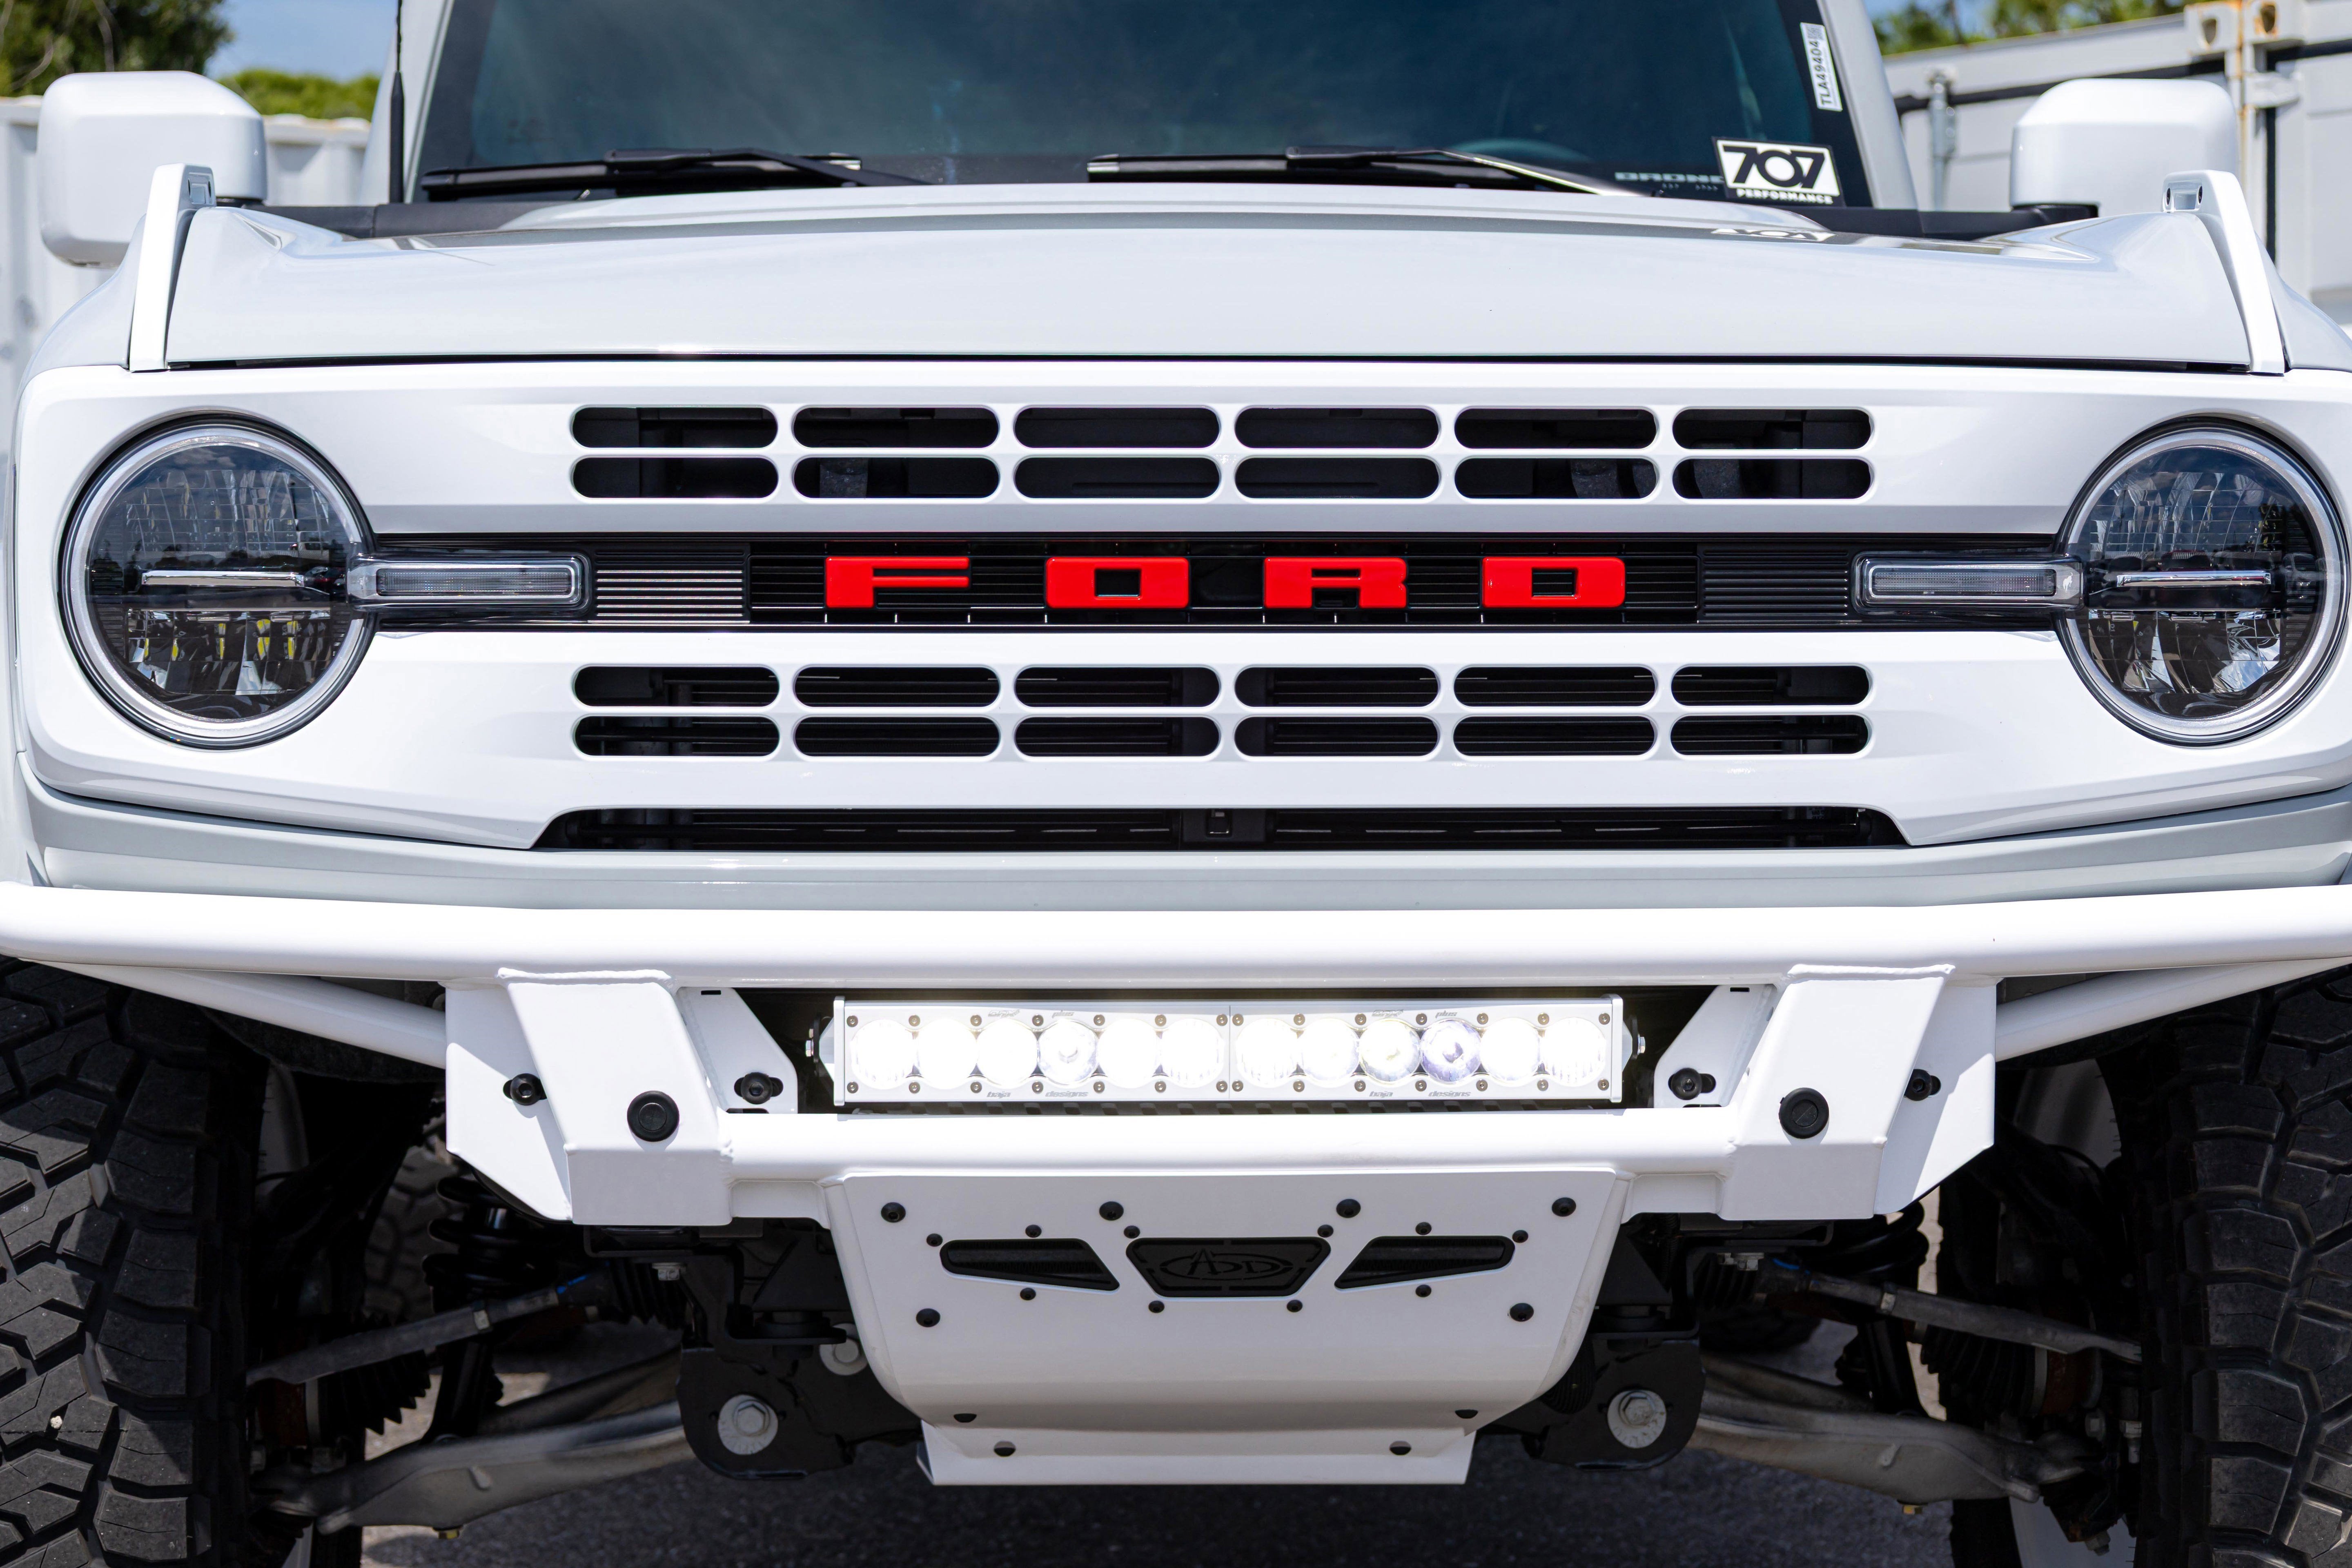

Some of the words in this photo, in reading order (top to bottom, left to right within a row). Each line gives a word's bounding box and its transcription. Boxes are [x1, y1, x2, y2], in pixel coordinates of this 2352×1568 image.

[1809, 40, 1832, 105] TLA49404
[1723, 145, 1825, 189] 707
[1736, 188, 1833, 204] PERFORMANCE
[825, 557, 1625, 608] FORD
